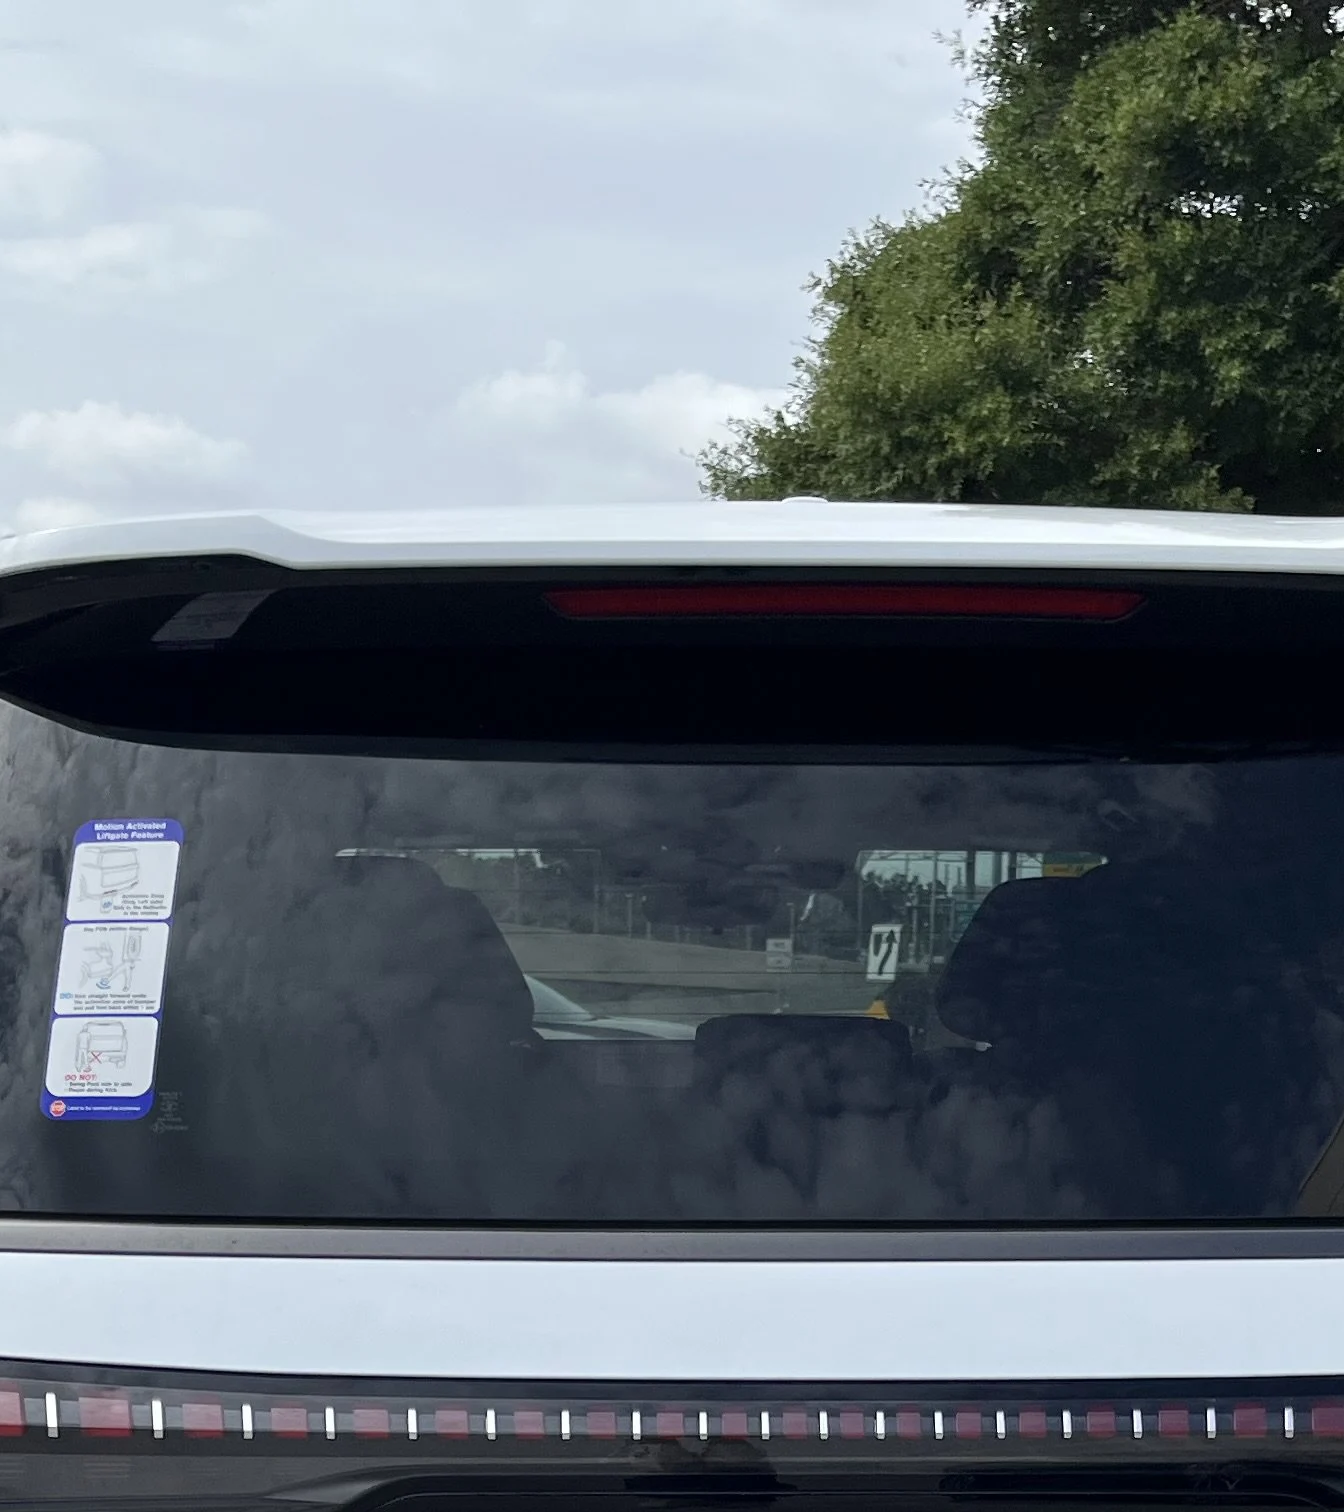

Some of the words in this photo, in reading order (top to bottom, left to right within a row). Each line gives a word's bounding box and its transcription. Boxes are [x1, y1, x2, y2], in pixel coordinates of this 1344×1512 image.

[126, 822, 166, 830] Activated
[97, 831, 129, 840] Liftgate
[131, 831, 164, 839] Feature
